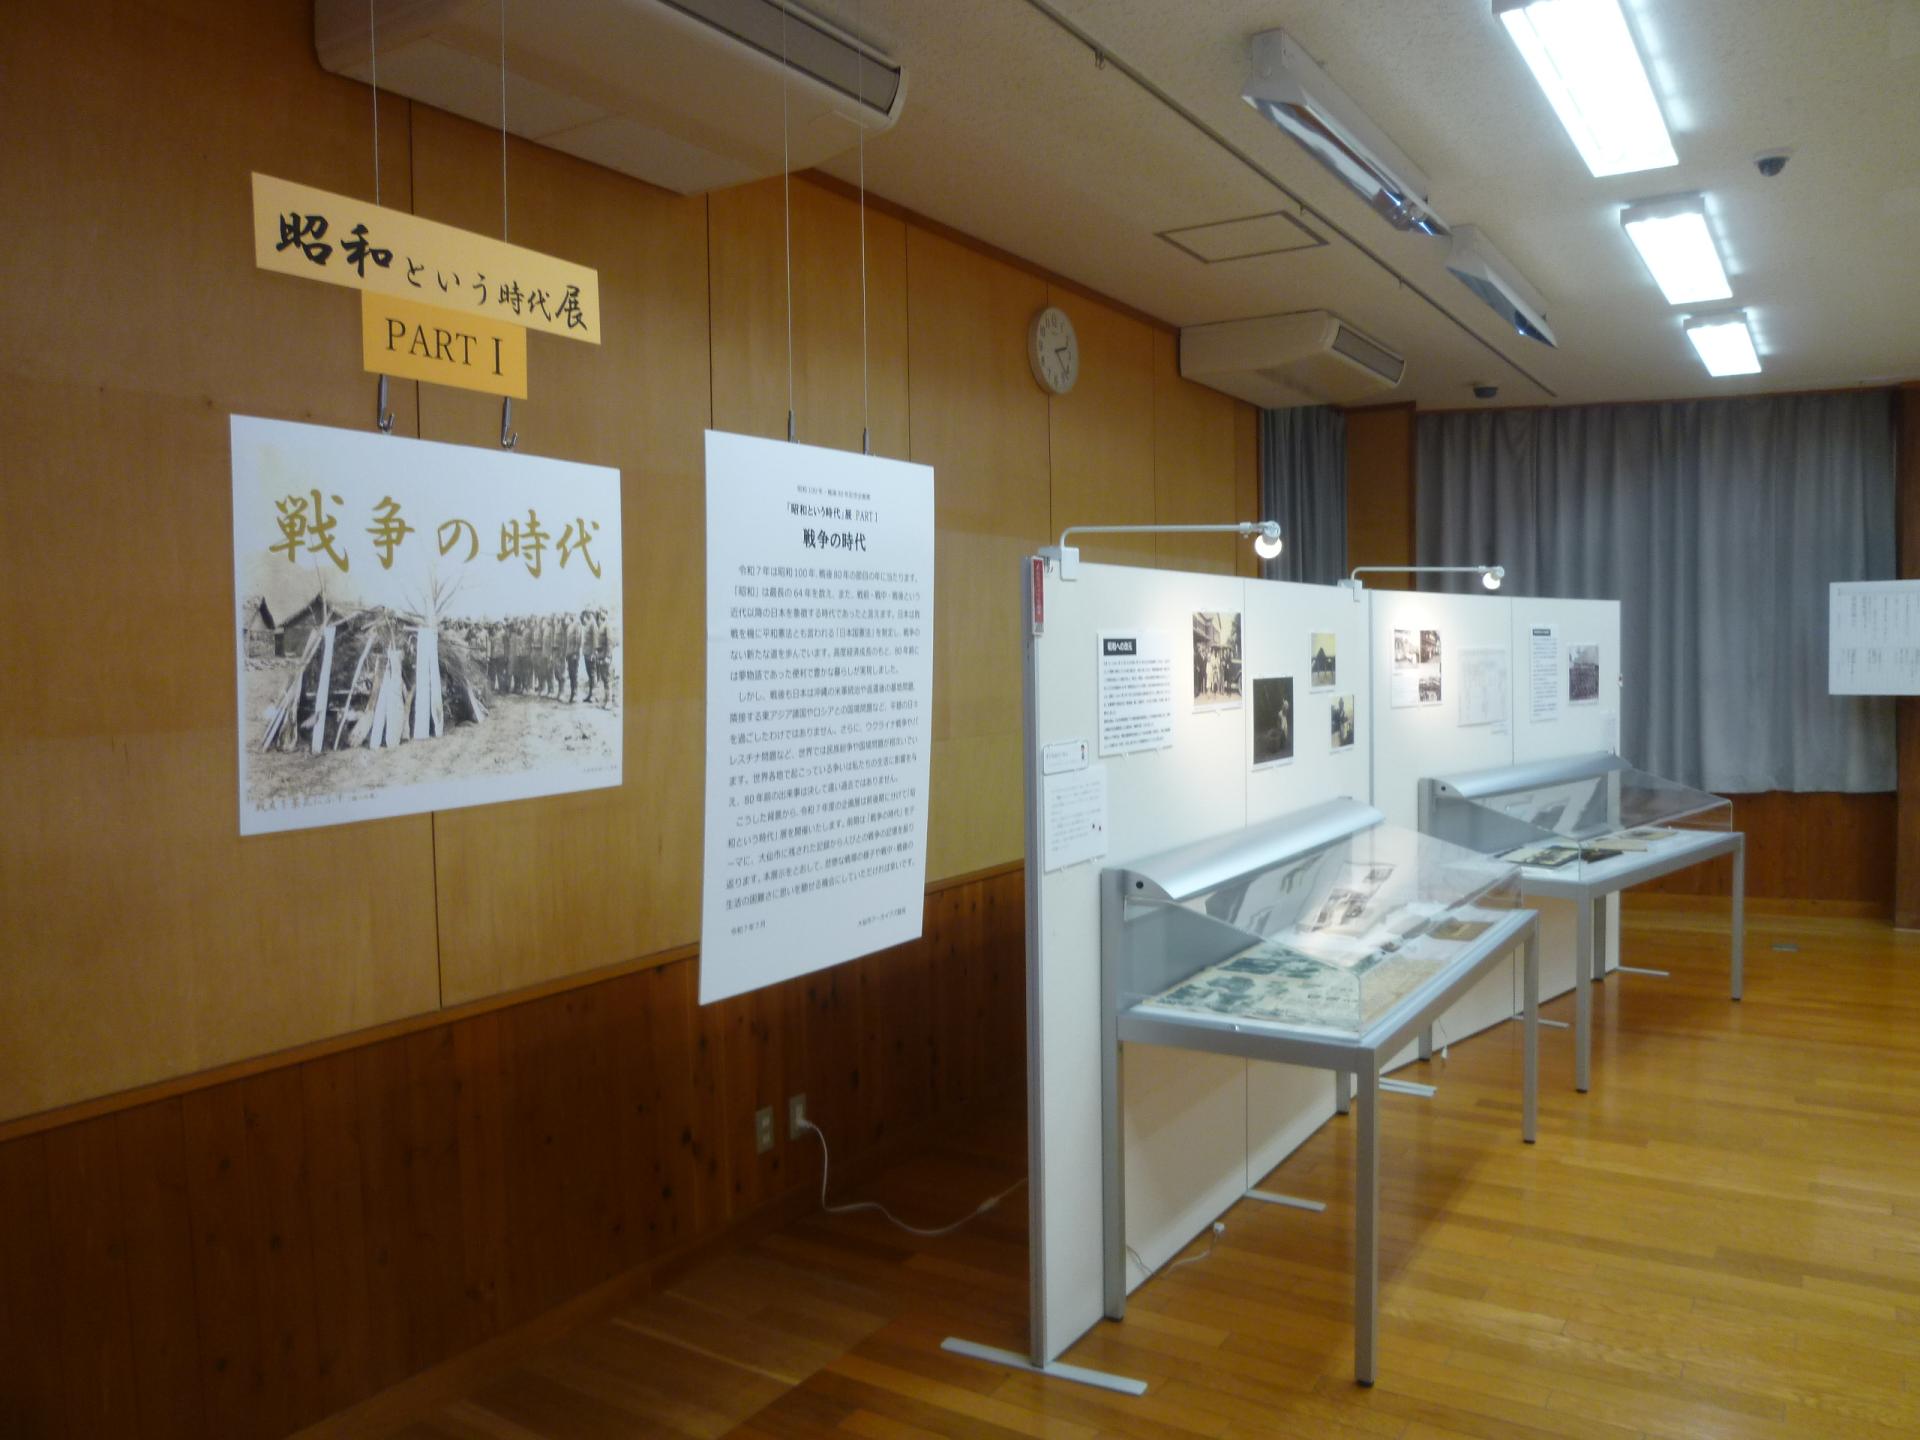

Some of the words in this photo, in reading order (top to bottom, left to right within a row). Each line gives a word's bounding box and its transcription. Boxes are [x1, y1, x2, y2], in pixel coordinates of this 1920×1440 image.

[276, 211, 588, 331] 昭和という時代展
[385, 317, 478, 366] PART
[269, 488, 602, 580] 戦争の時代
[802, 527, 867, 552] 戦争の時代
[855, 509, 872, 523] PART
